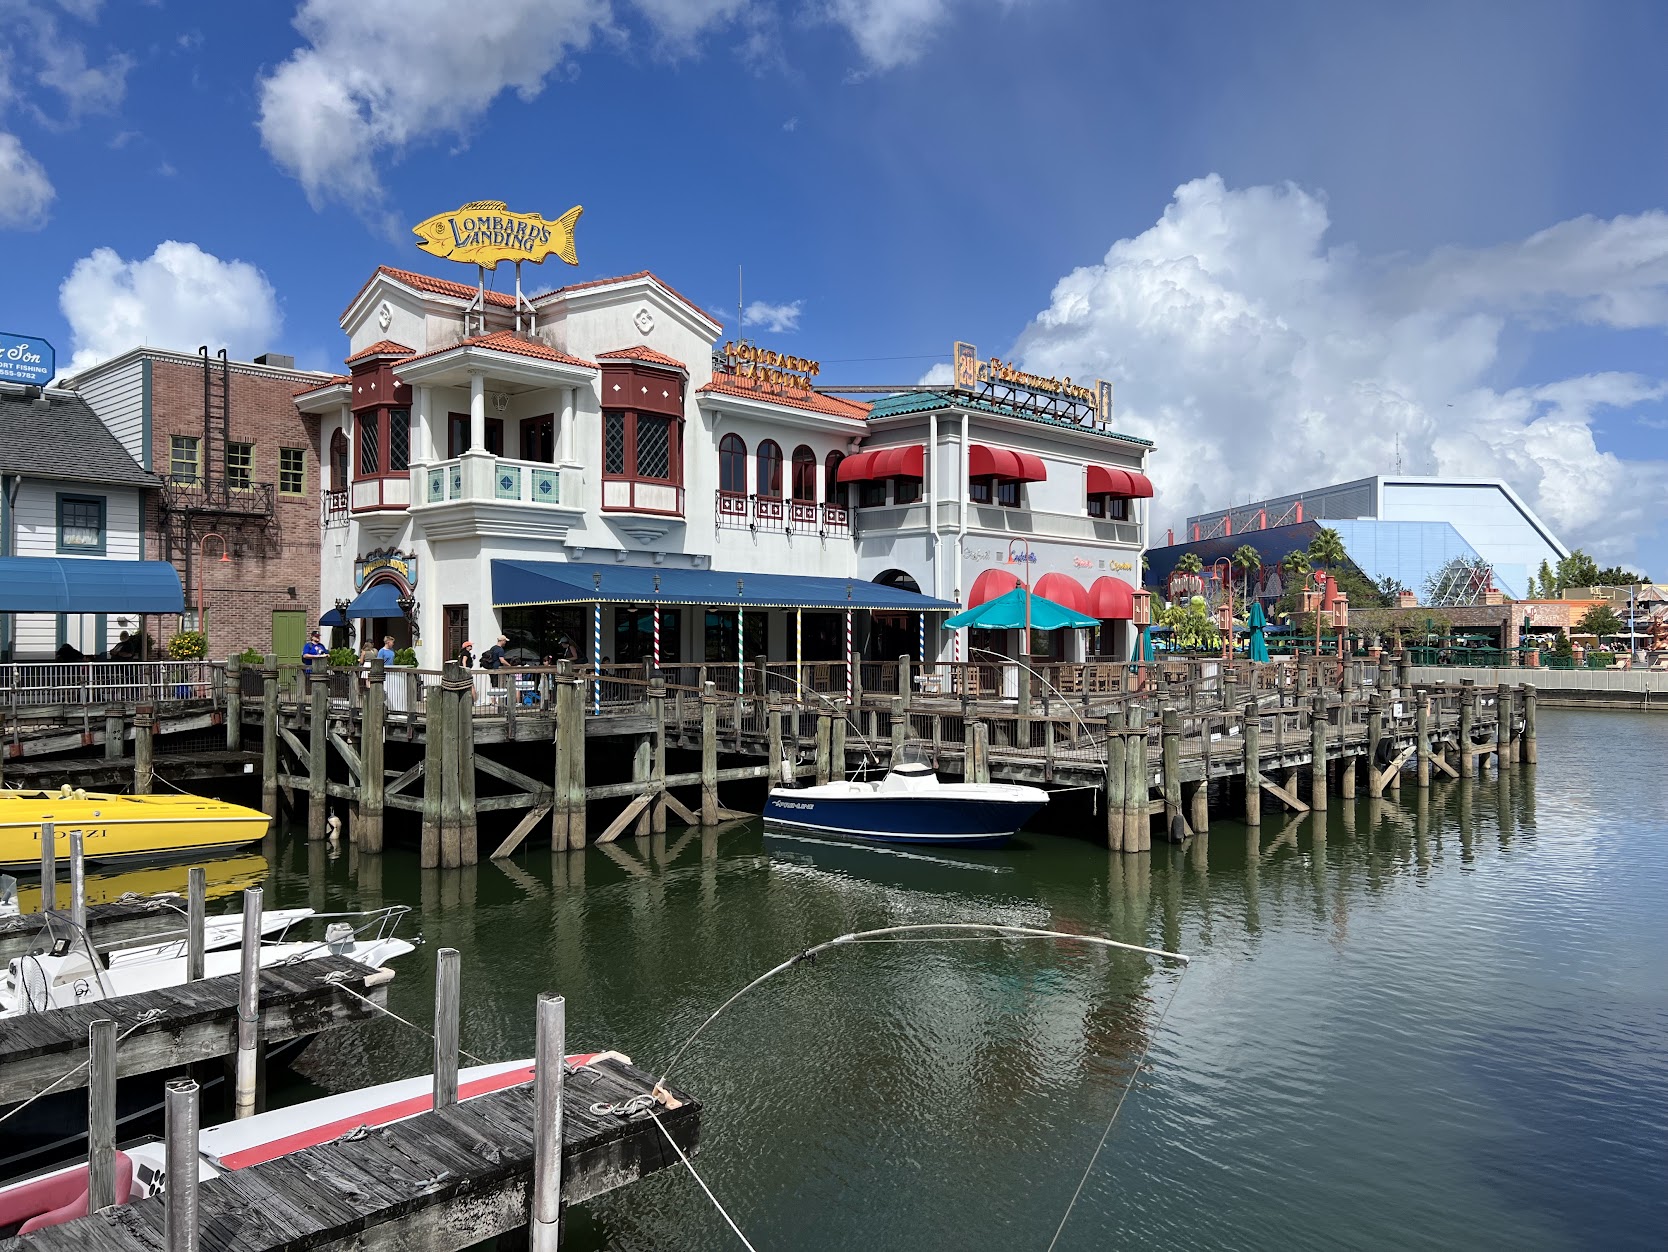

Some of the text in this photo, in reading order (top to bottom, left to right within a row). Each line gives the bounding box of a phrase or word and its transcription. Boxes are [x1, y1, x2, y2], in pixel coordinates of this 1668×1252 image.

[449, 217, 552, 249] LOMBARD'S
[454, 228, 535, 253] LANDING
[7, 343, 41, 364] Son
[15, 364, 48, 374] FISHING
